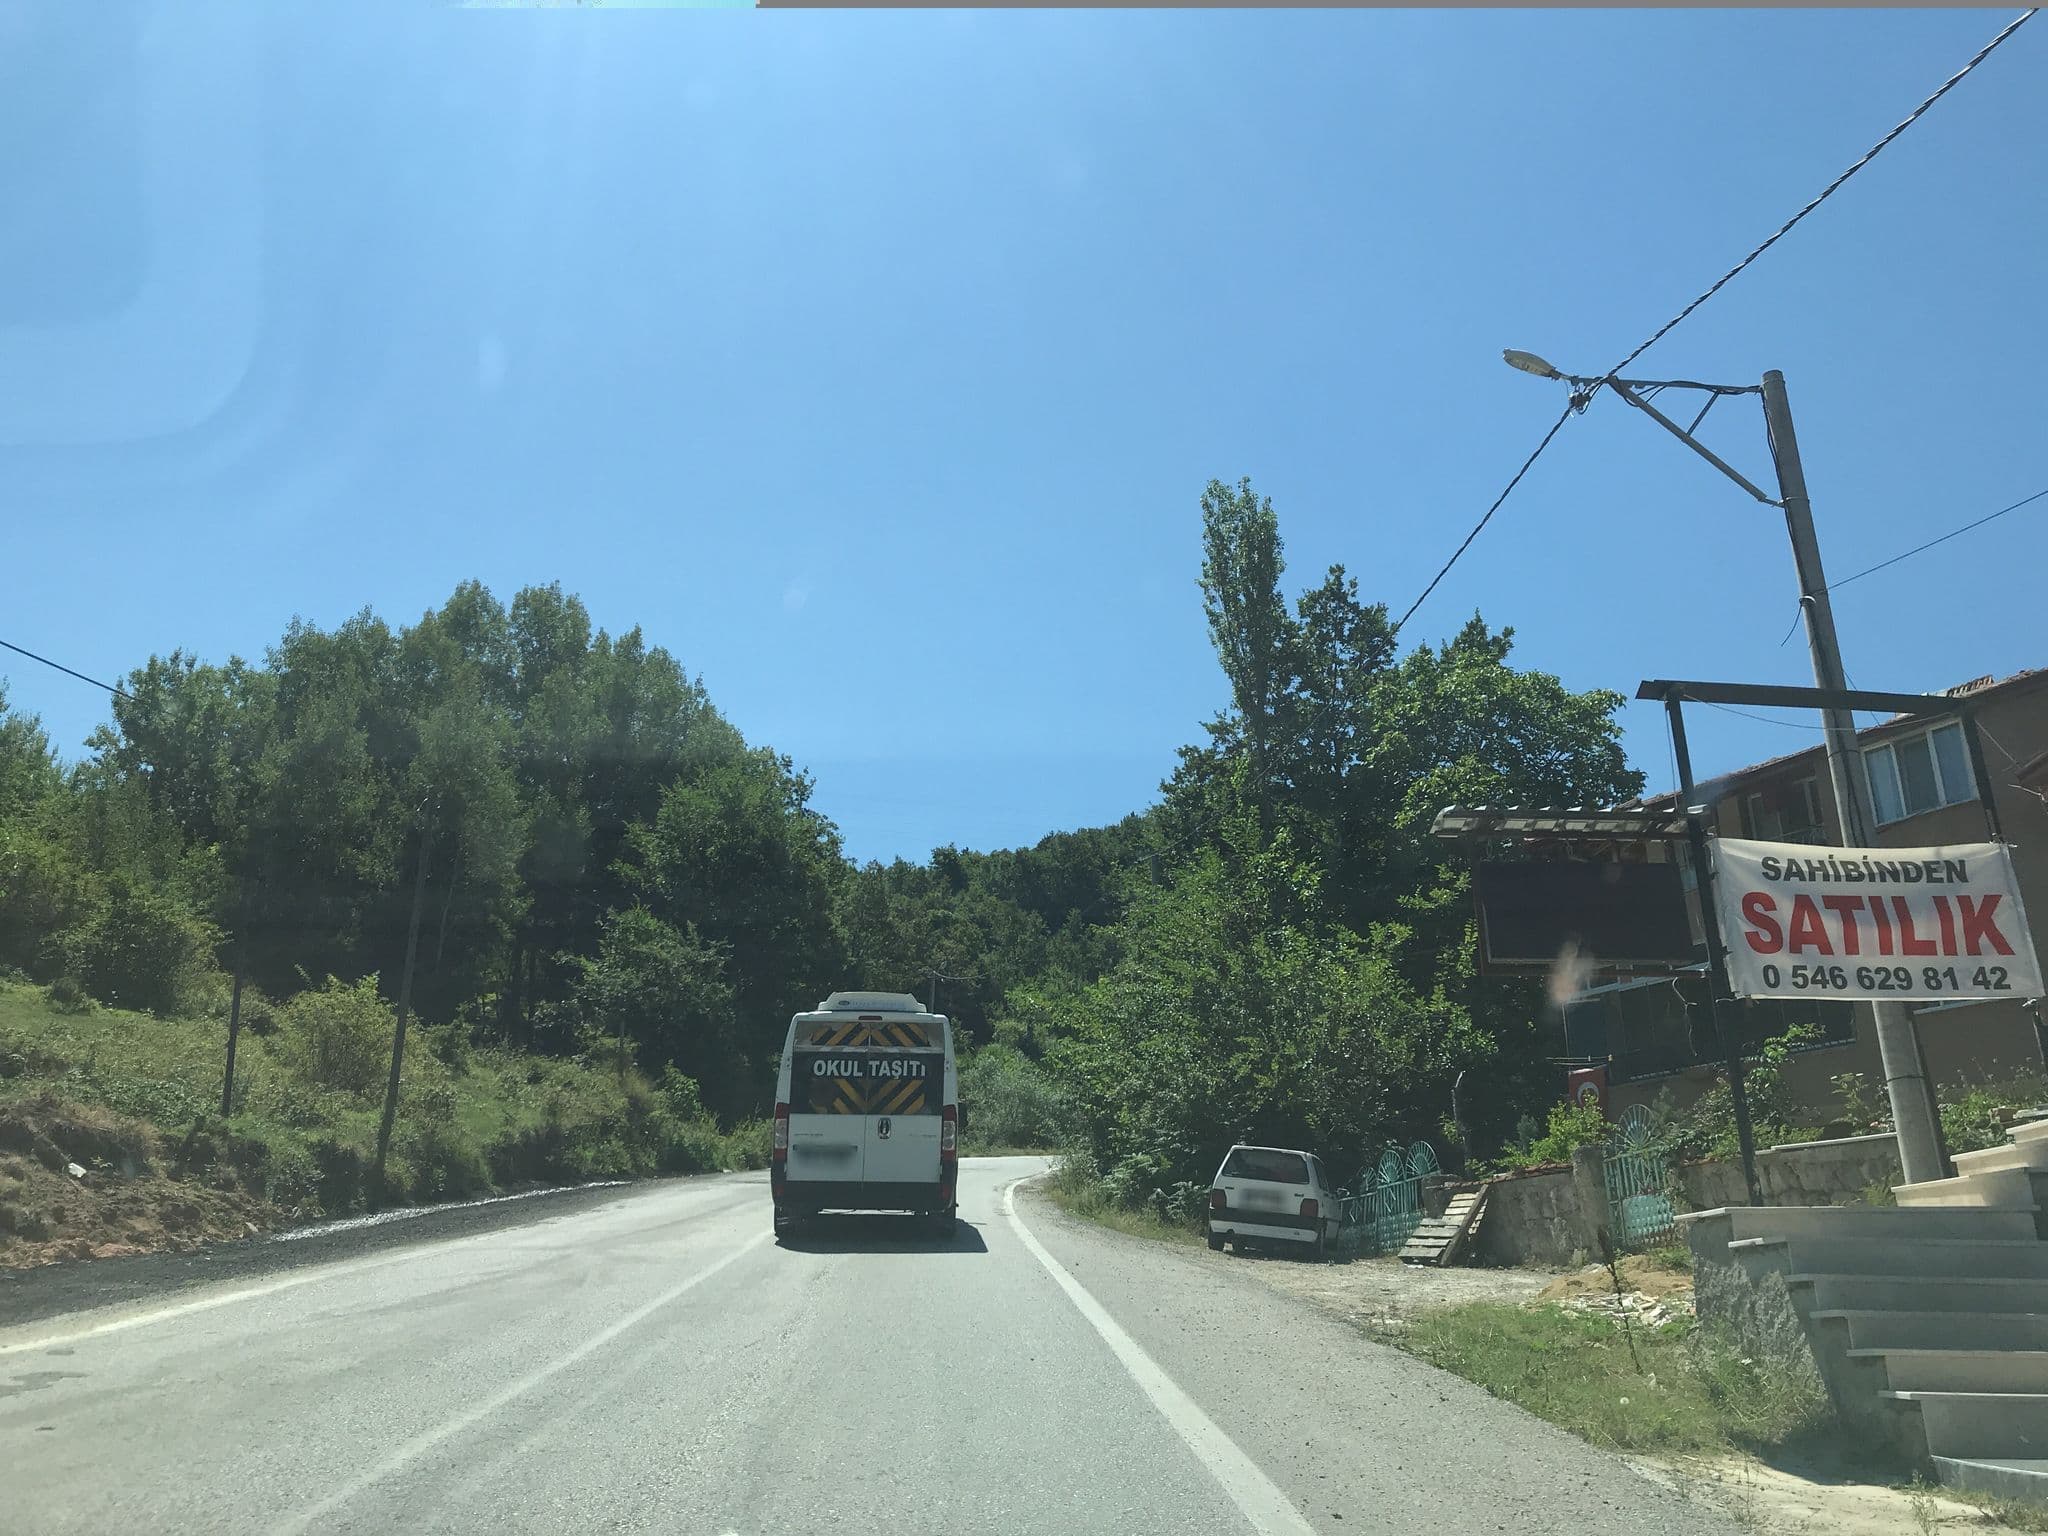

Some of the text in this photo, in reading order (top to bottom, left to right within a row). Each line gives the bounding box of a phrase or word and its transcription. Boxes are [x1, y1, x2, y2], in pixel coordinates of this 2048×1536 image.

[1761, 854, 1969, 883] SAHİBİNDEN
[1741, 891, 2016, 956] SATILIK
[1763, 964, 2012, 991] 0 546 629 81 42
[813, 1059, 863, 1077] OKUL
